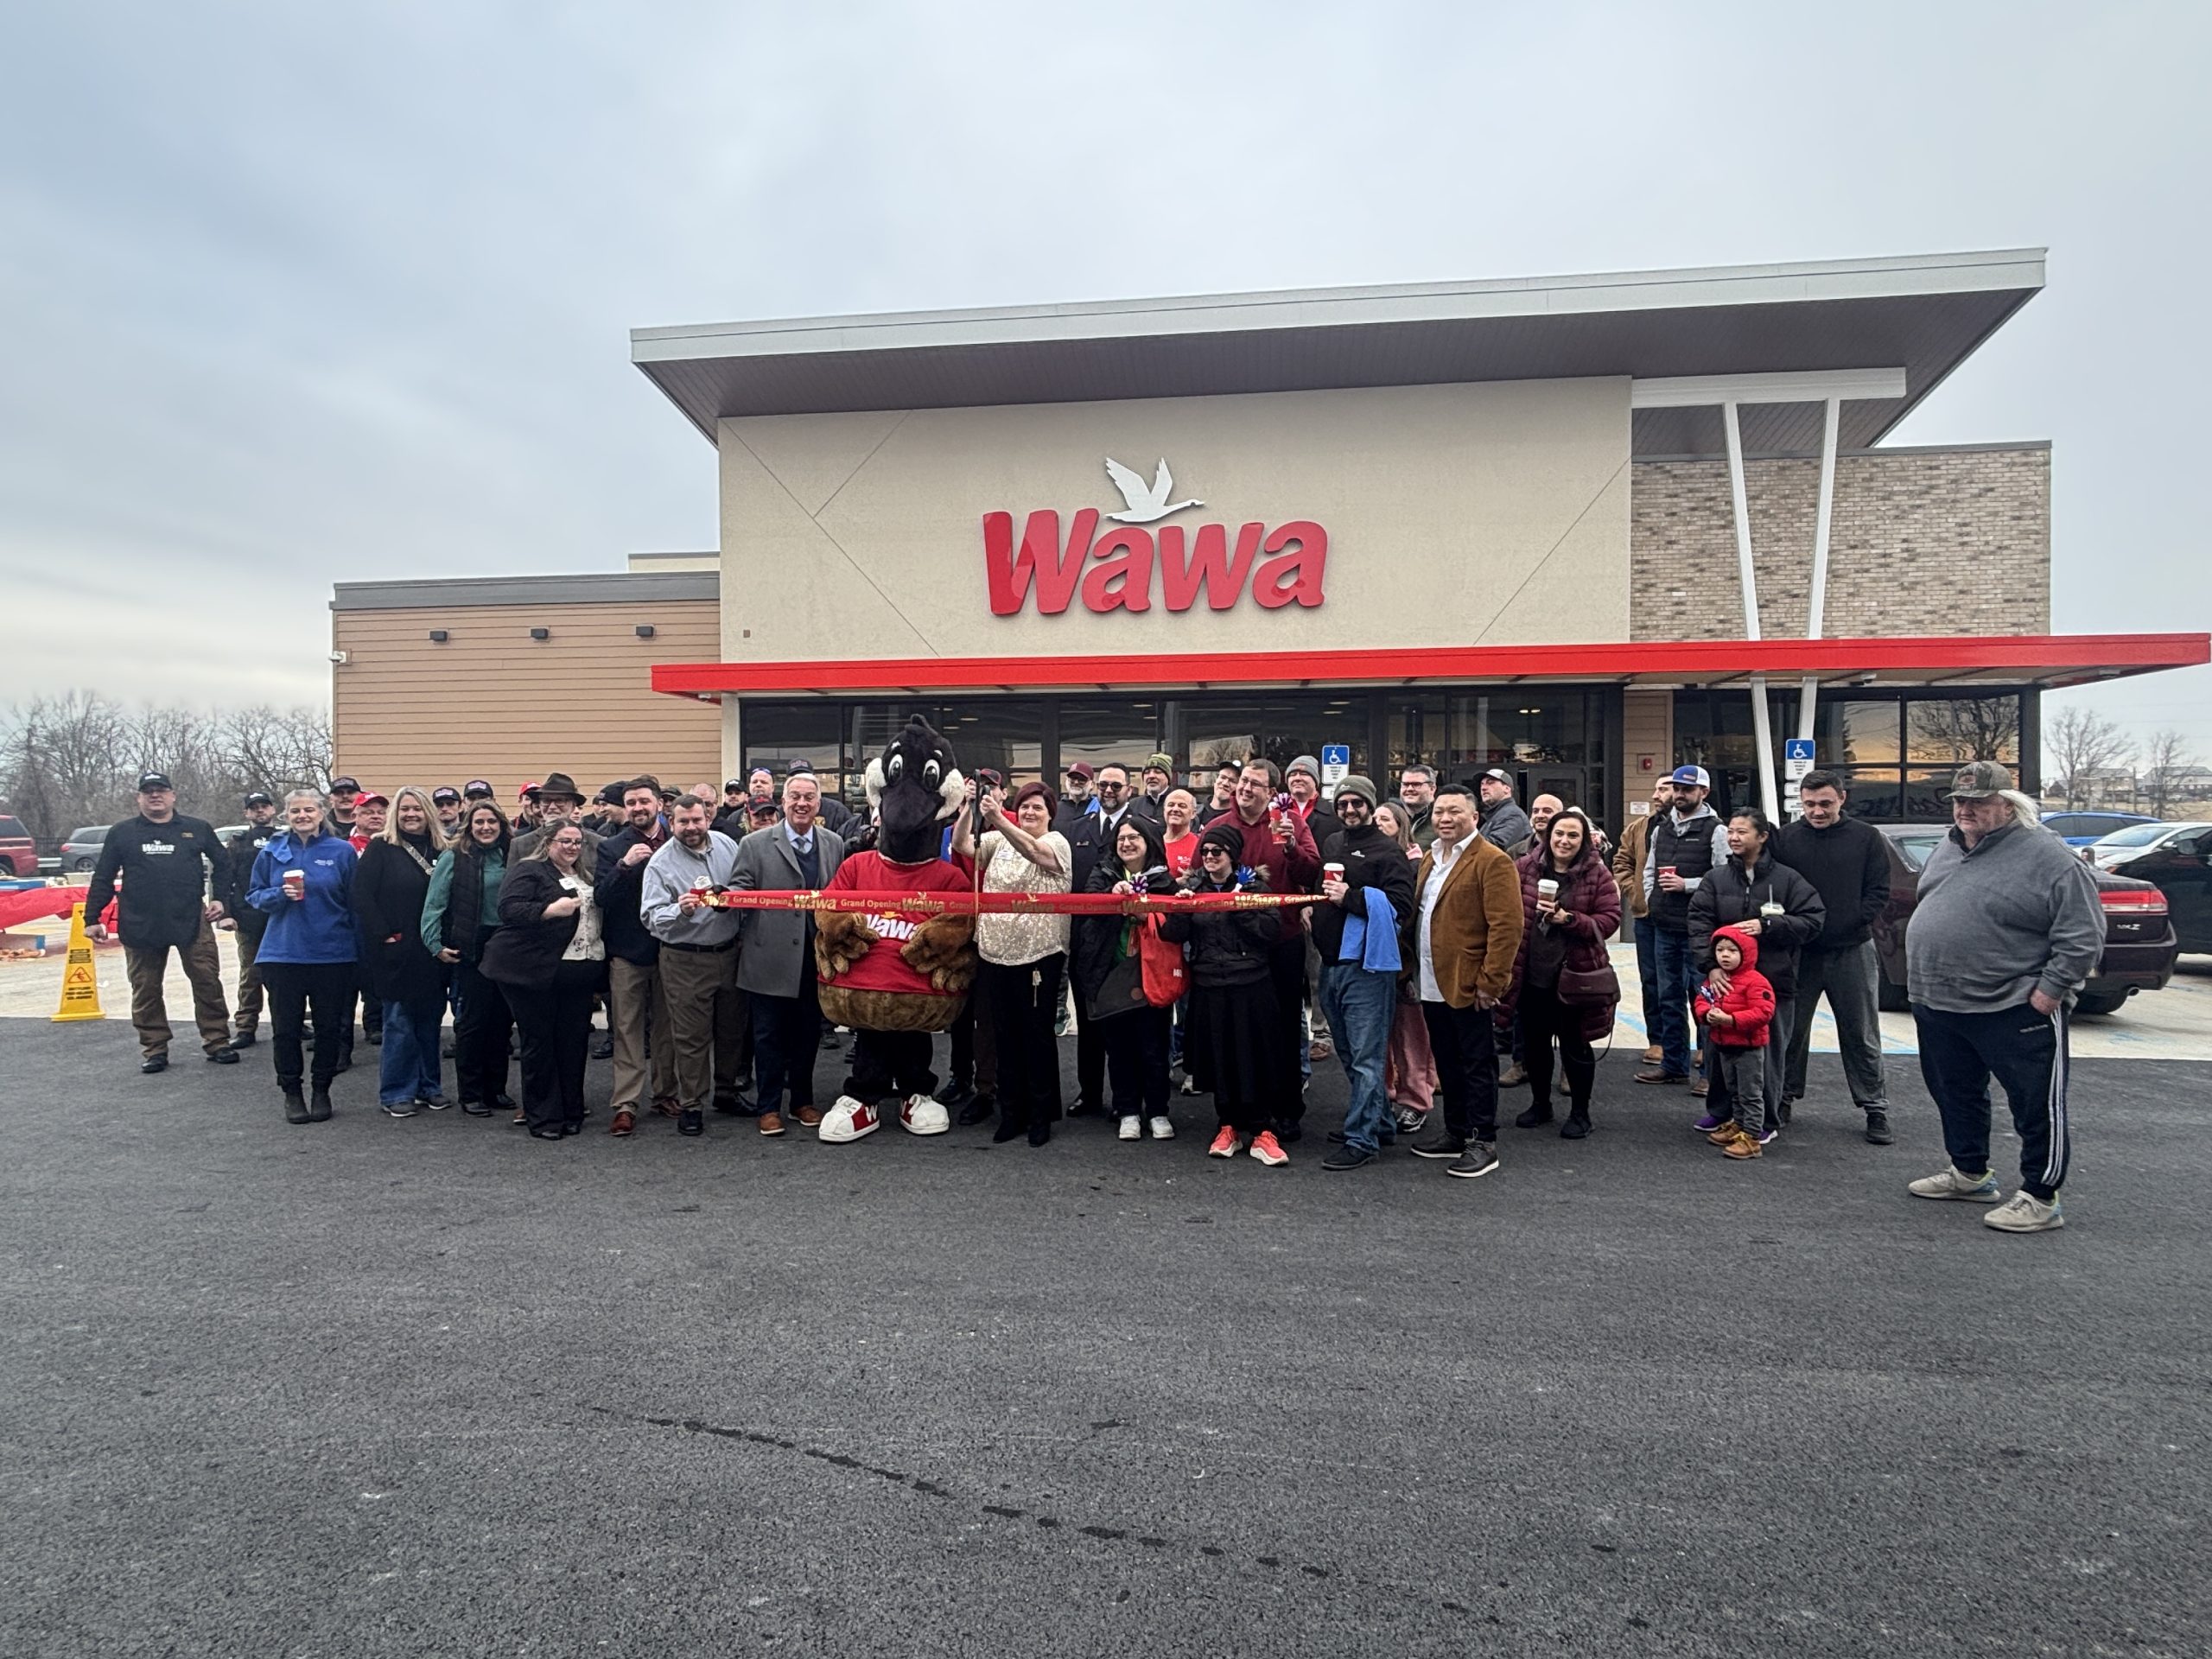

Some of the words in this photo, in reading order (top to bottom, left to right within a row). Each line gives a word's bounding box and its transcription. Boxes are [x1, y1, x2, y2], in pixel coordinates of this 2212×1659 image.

[983, 508, 1328, 615] Wawa
[733, 896, 758, 905] Grand
[759, 897, 793, 907] Opening
[794, 894, 836, 910] Wawa
[840, 899, 865, 907] Grand
[867, 899, 901, 910] Opening
[902, 898, 945, 912] Wawa
[1011, 899, 1056, 912] Wawa
[1122, 899, 1166, 912] Wawa
